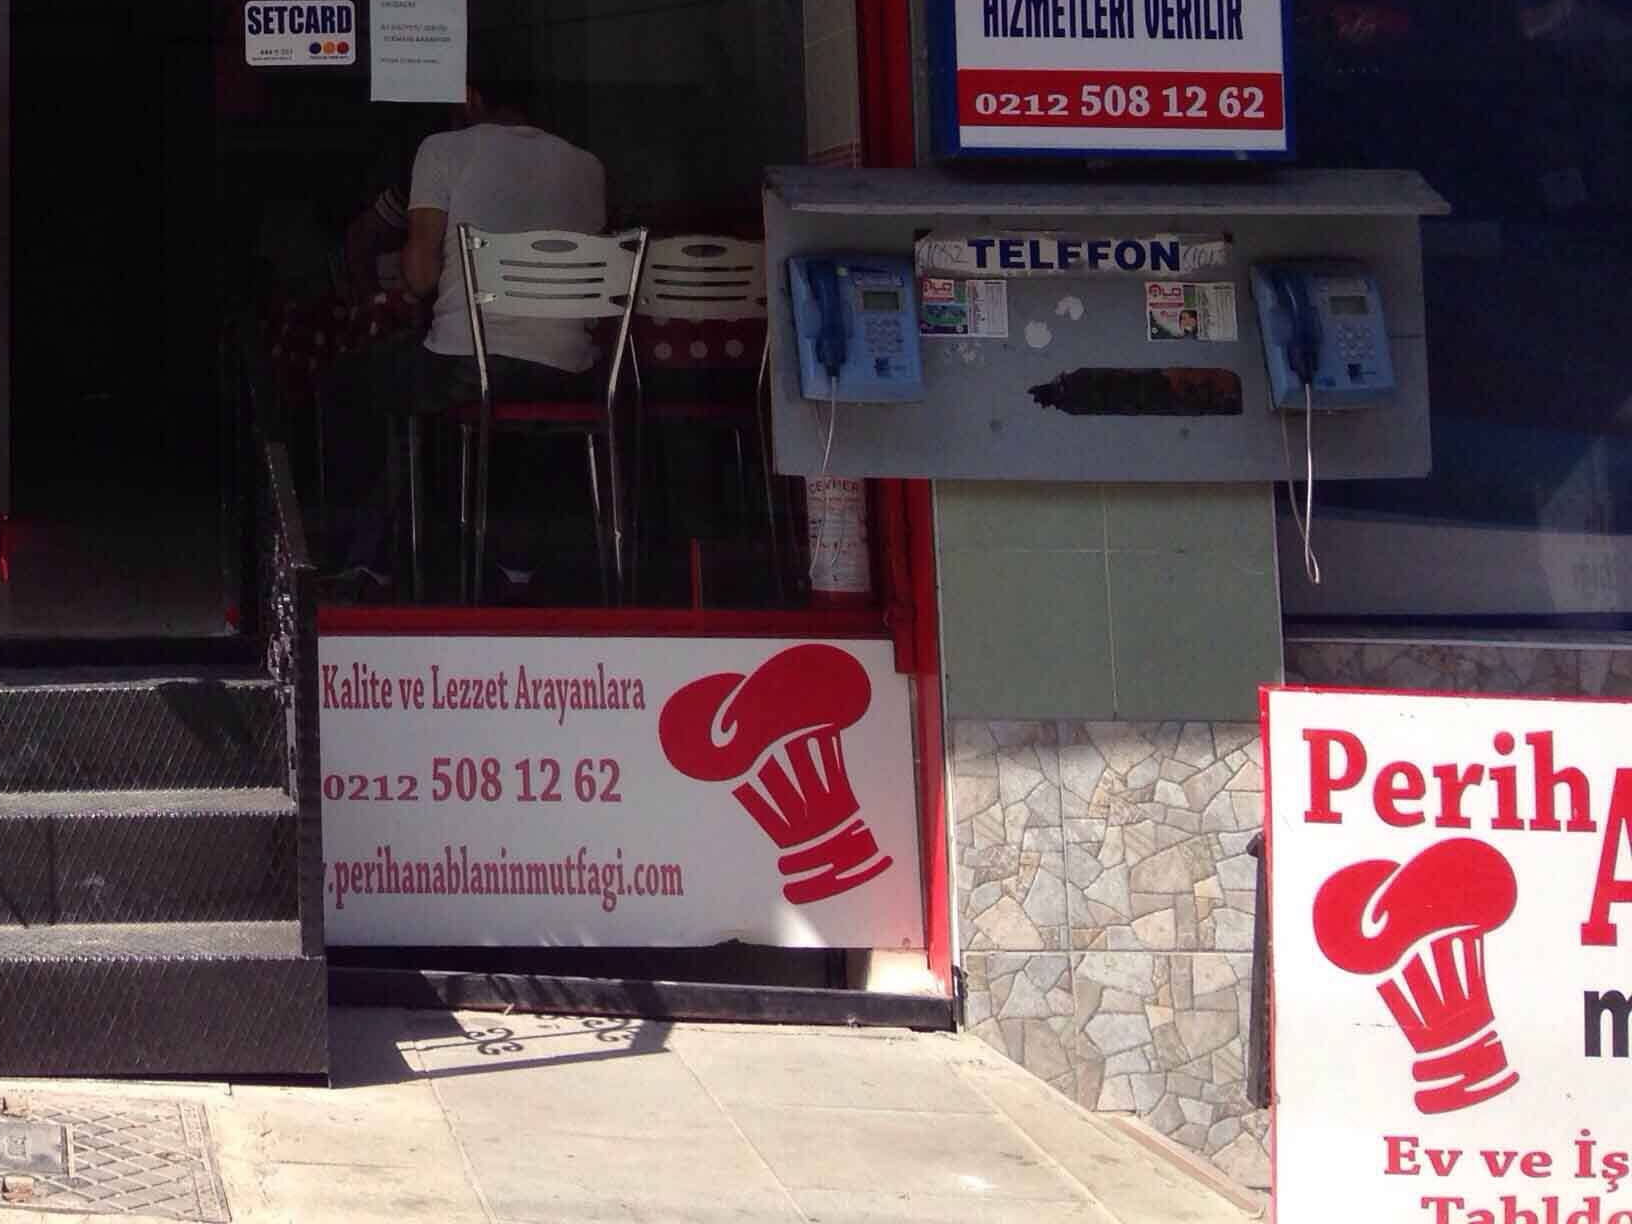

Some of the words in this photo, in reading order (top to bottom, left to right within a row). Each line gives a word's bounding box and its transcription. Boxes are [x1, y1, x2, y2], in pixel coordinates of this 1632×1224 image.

[247, 5, 353, 35] SETCARD
[976, 92, 1069, 116] 0212
[1081, 85, 1150, 117] 508
[1162, 86, 1208, 118] 12
[1218, 86, 1265, 119] 62
[967, 239, 1181, 271] TELEFON
[323, 662, 393, 712] Kalite
[399, 676, 425, 710] ve
[431, 664, 509, 711] Lezzet
[514, 663, 646, 726] Arayanlara
[323, 775, 419, 802] 0212
[431, 757, 502, 803] 508
[514, 758, 562, 803] 12
[574, 758, 622, 804] 62
[321, 846, 685, 913] .perihanablaninmutfagi.com
[1383, 1135, 1464, 1178] Ev
[1479, 1150, 1553, 1178] ve
[1574, 1128, 1631, 1194] İş
